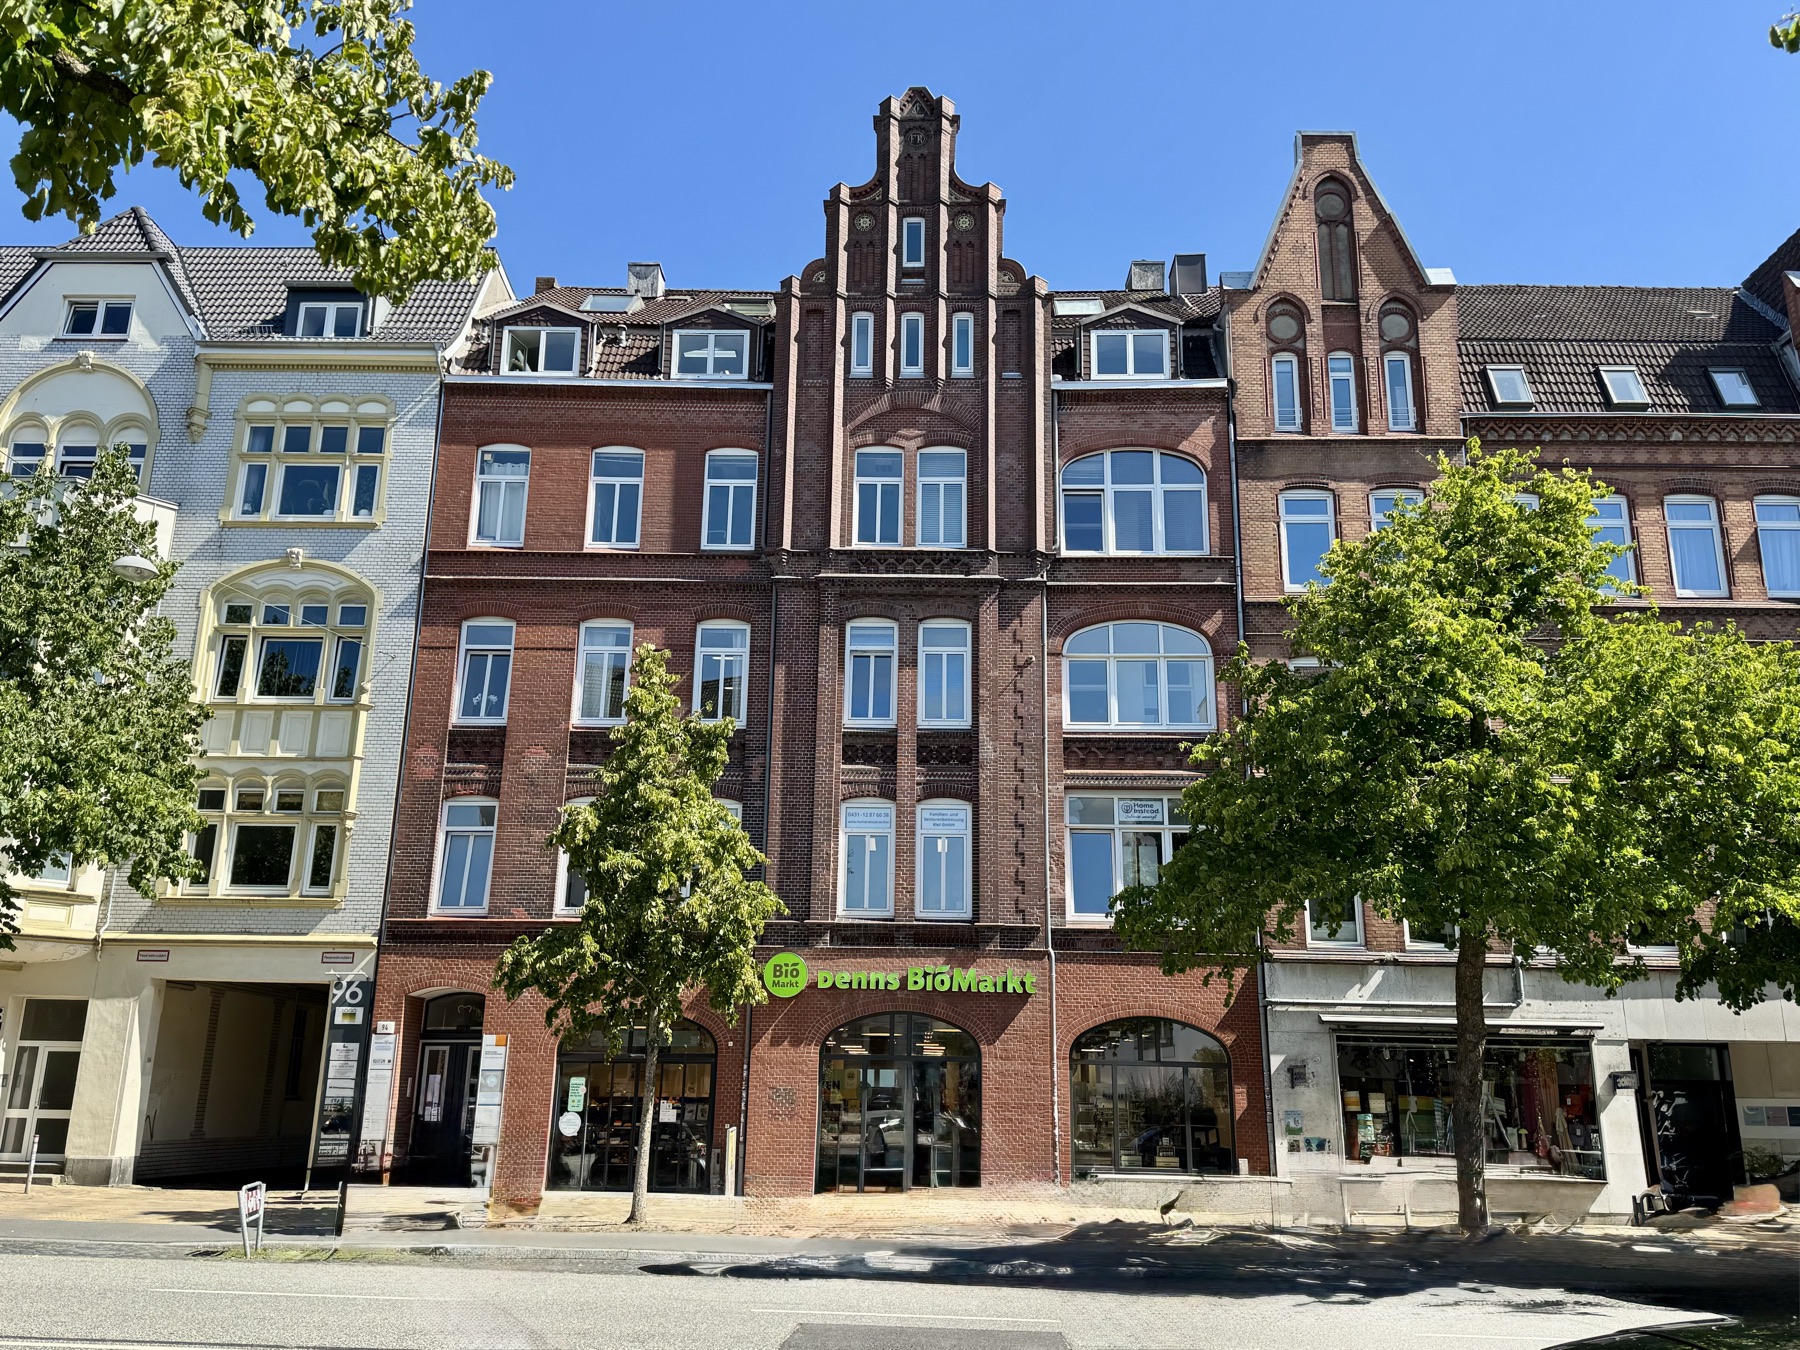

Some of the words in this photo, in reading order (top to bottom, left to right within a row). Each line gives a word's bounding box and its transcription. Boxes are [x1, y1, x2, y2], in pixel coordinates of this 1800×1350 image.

[772, 962, 800, 979] Bio
[331, 980, 363, 1004] 96
[772, 979, 800, 988] Markt
